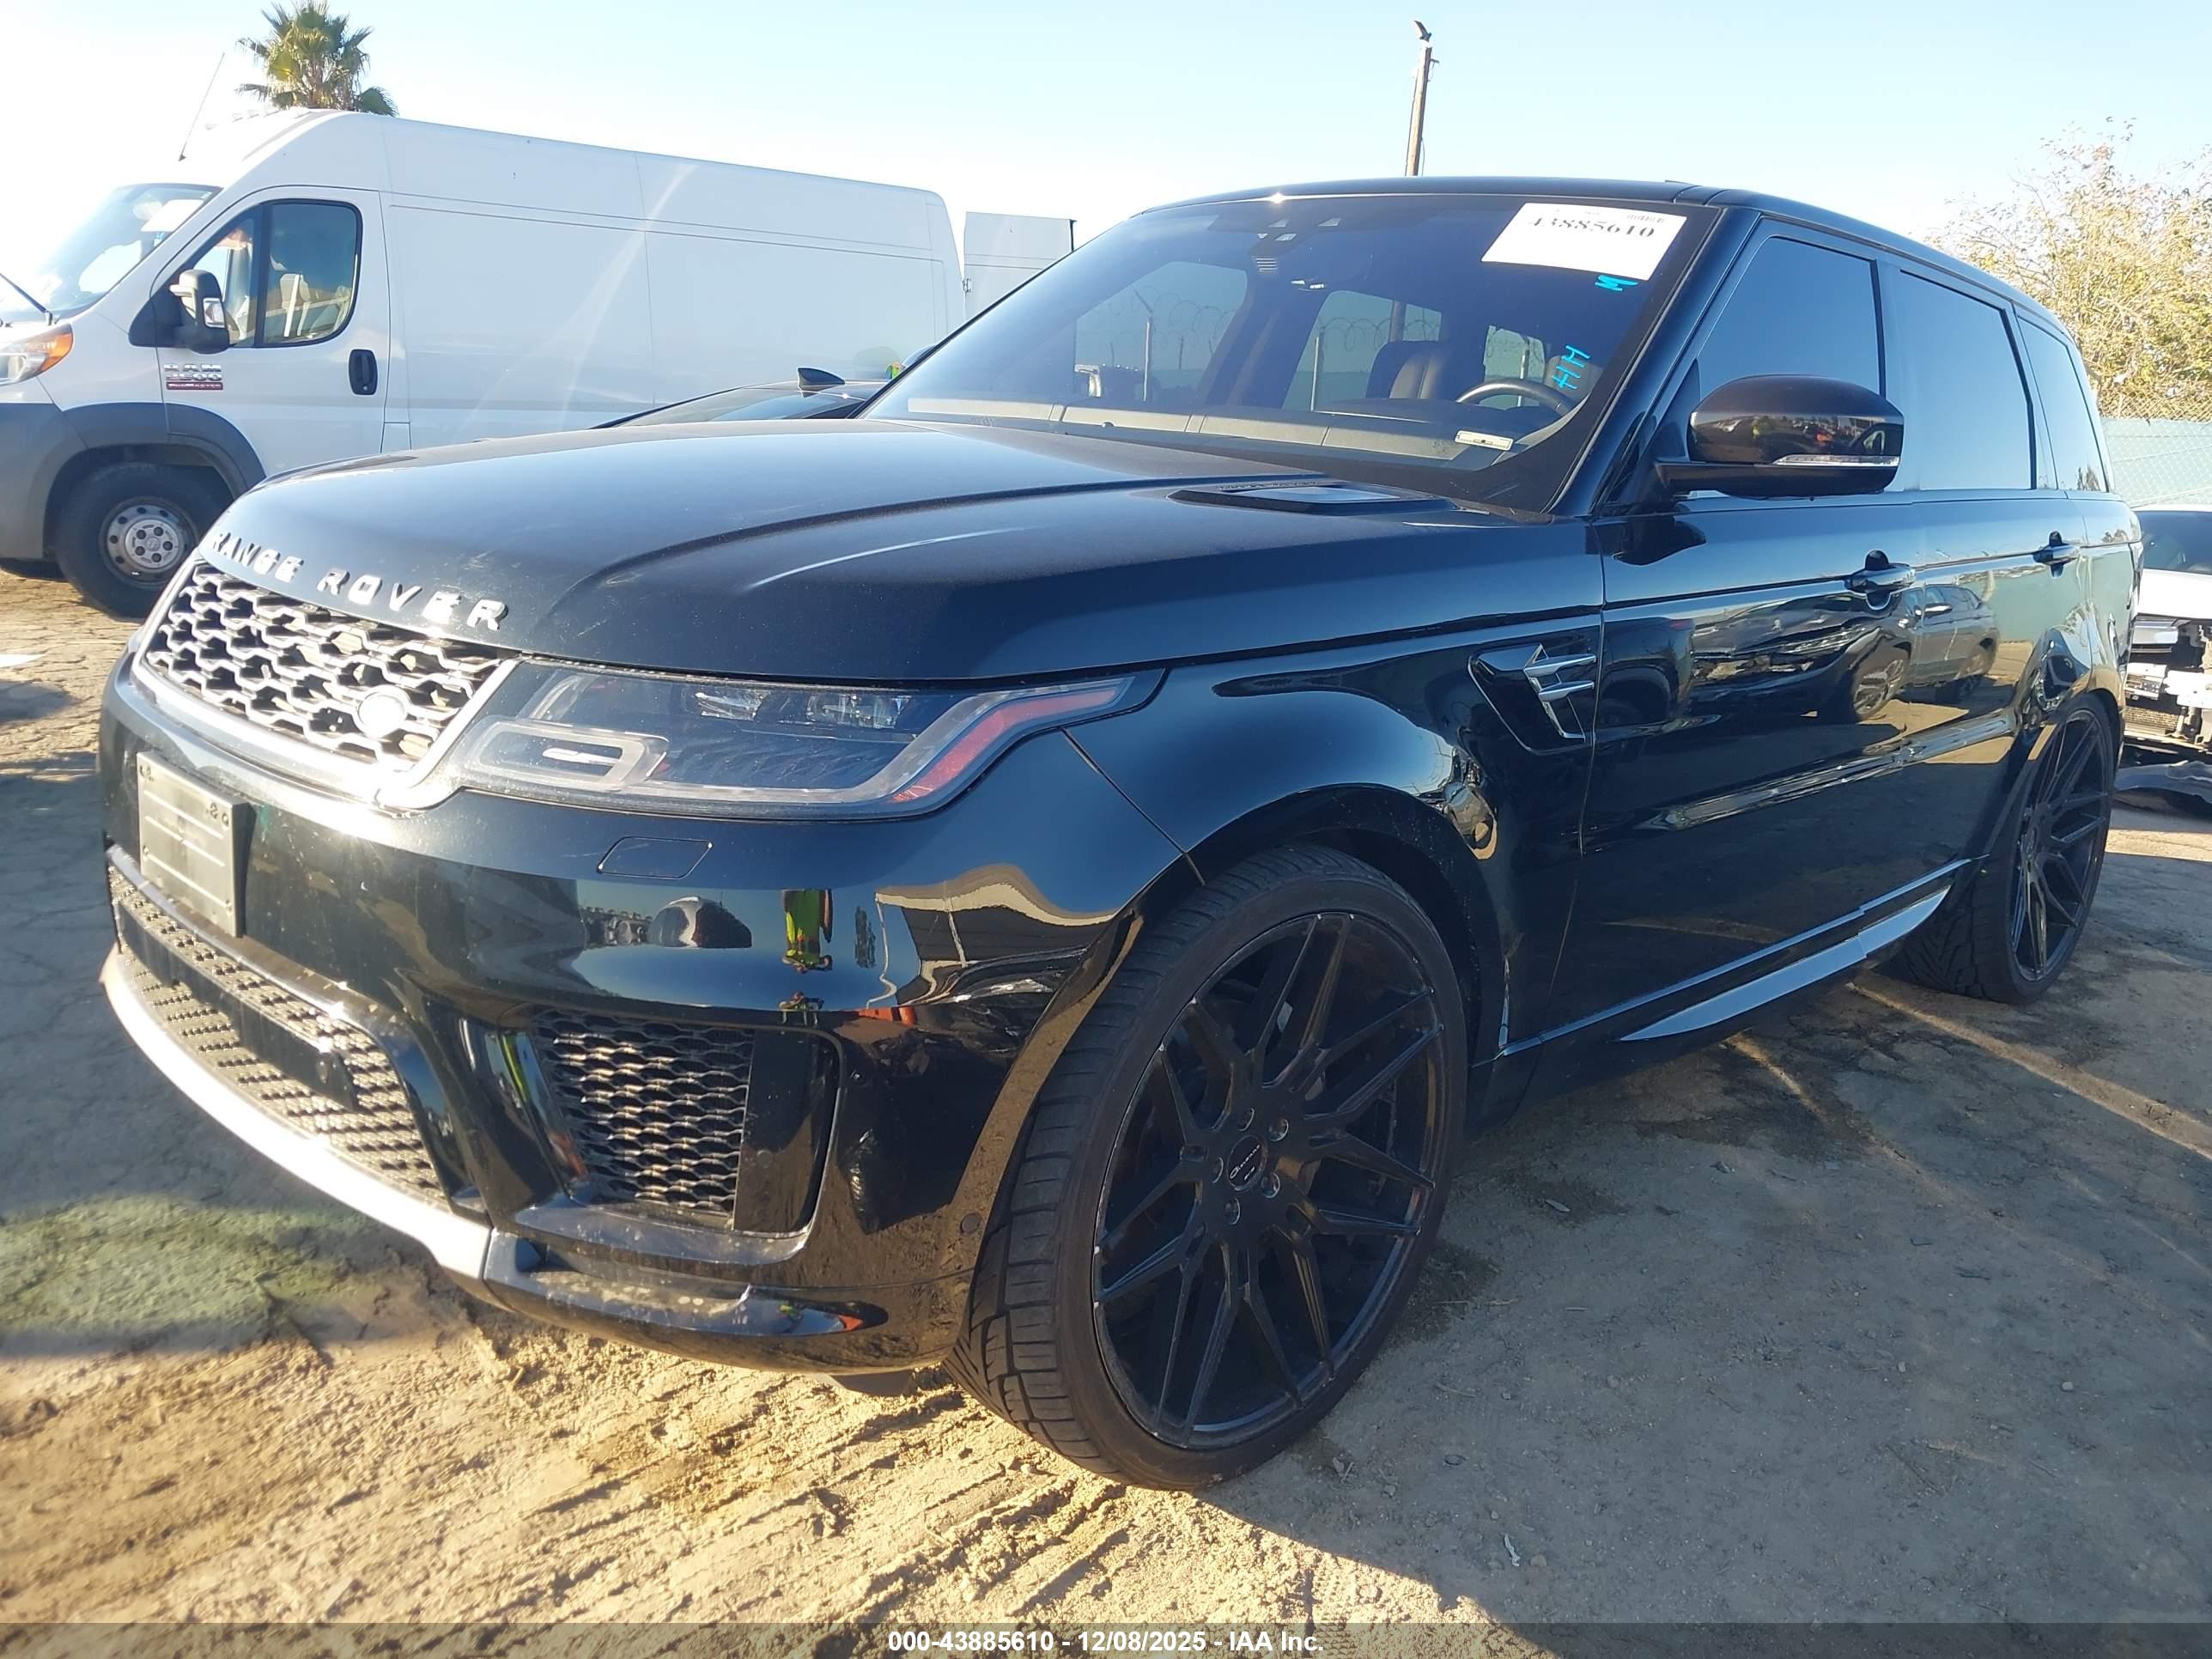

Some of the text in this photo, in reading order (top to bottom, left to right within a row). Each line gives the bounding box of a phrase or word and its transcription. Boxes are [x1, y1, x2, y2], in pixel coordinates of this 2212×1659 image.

[162, 363, 222, 373] RAM
[211, 532, 509, 632] RANGE ROVER
